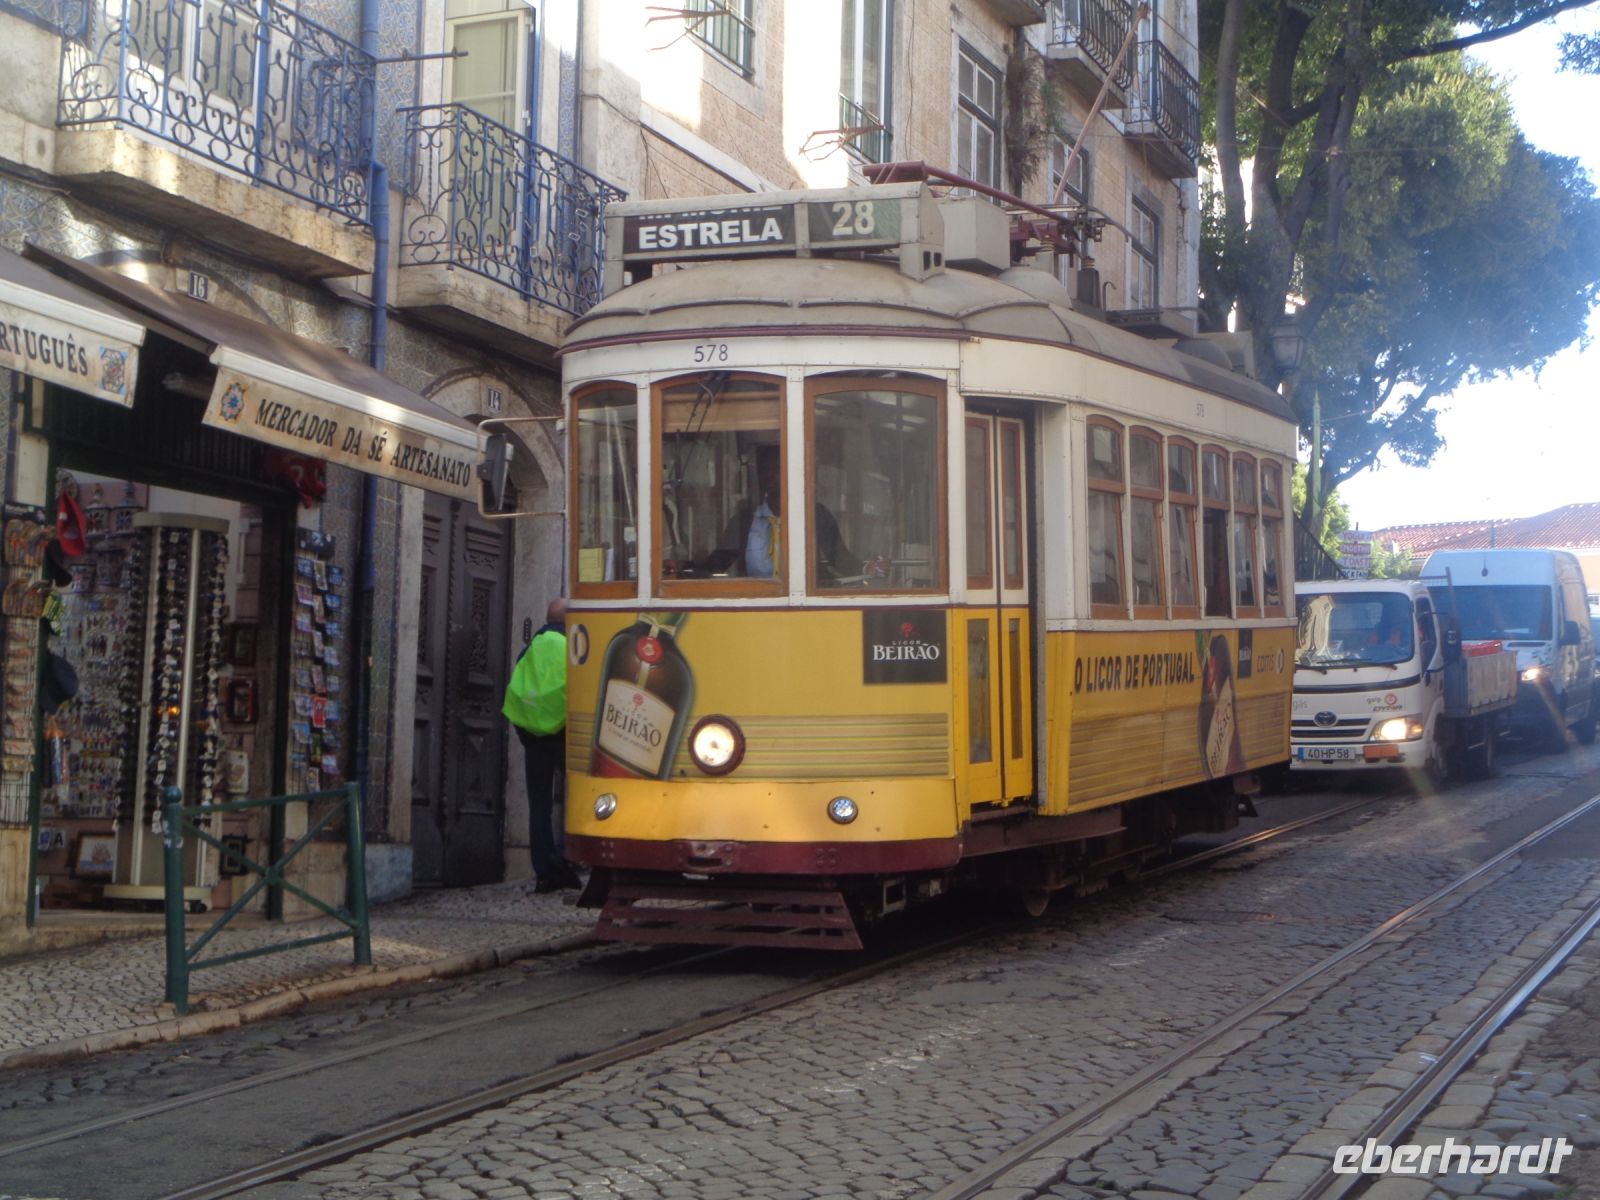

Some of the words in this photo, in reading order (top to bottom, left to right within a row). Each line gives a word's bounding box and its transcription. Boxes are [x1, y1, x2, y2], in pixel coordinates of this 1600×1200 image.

[639, 217, 784, 250] ESTRELA
[832, 200, 875, 237] 28
[193, 274, 205, 298] 16
[694, 344, 729, 363] 578
[255, 399, 338, 447] MERCADOR
[341, 426, 362, 456] DA
[368, 431, 388, 462] SÉ
[390, 443, 471, 488] ARTESANATO
[872, 643, 940, 661] BEIRÃO
[1074, 656, 1083, 693] O
[1086, 654, 1122, 692] LICOR
[1125, 654, 1140, 688] DE
[1142, 652, 1195, 688] PORTUGAL
[605, 703, 662, 747] BEIRÃO
